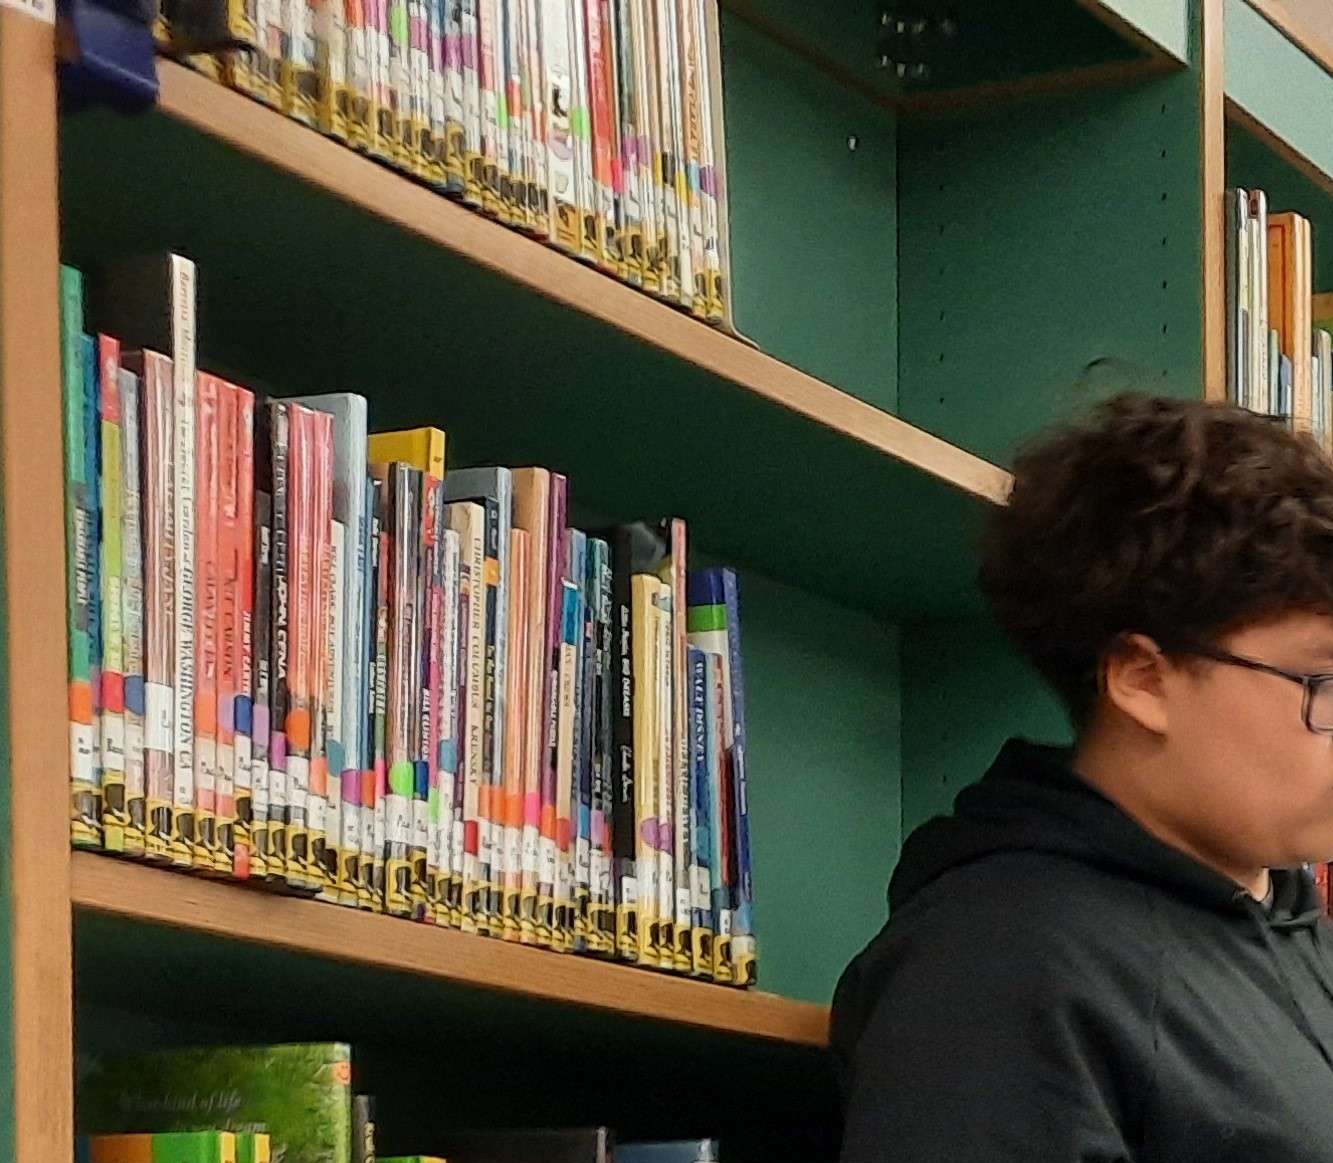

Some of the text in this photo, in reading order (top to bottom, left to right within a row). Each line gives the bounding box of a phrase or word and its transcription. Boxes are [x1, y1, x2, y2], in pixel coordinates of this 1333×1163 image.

[179, 567, 194, 633] GEORGE
[276, 576, 289, 627] JOHN
[471, 537, 482, 631] CHRISTOPHER
[223, 611, 236, 677] CARSON
[276, 629, 289, 680] CENA
[471, 635, 481, 709] COLUMBUS
[178, 640, 194, 745] WASHINGTON
[695, 662, 706, 763] WALT DISNEY
